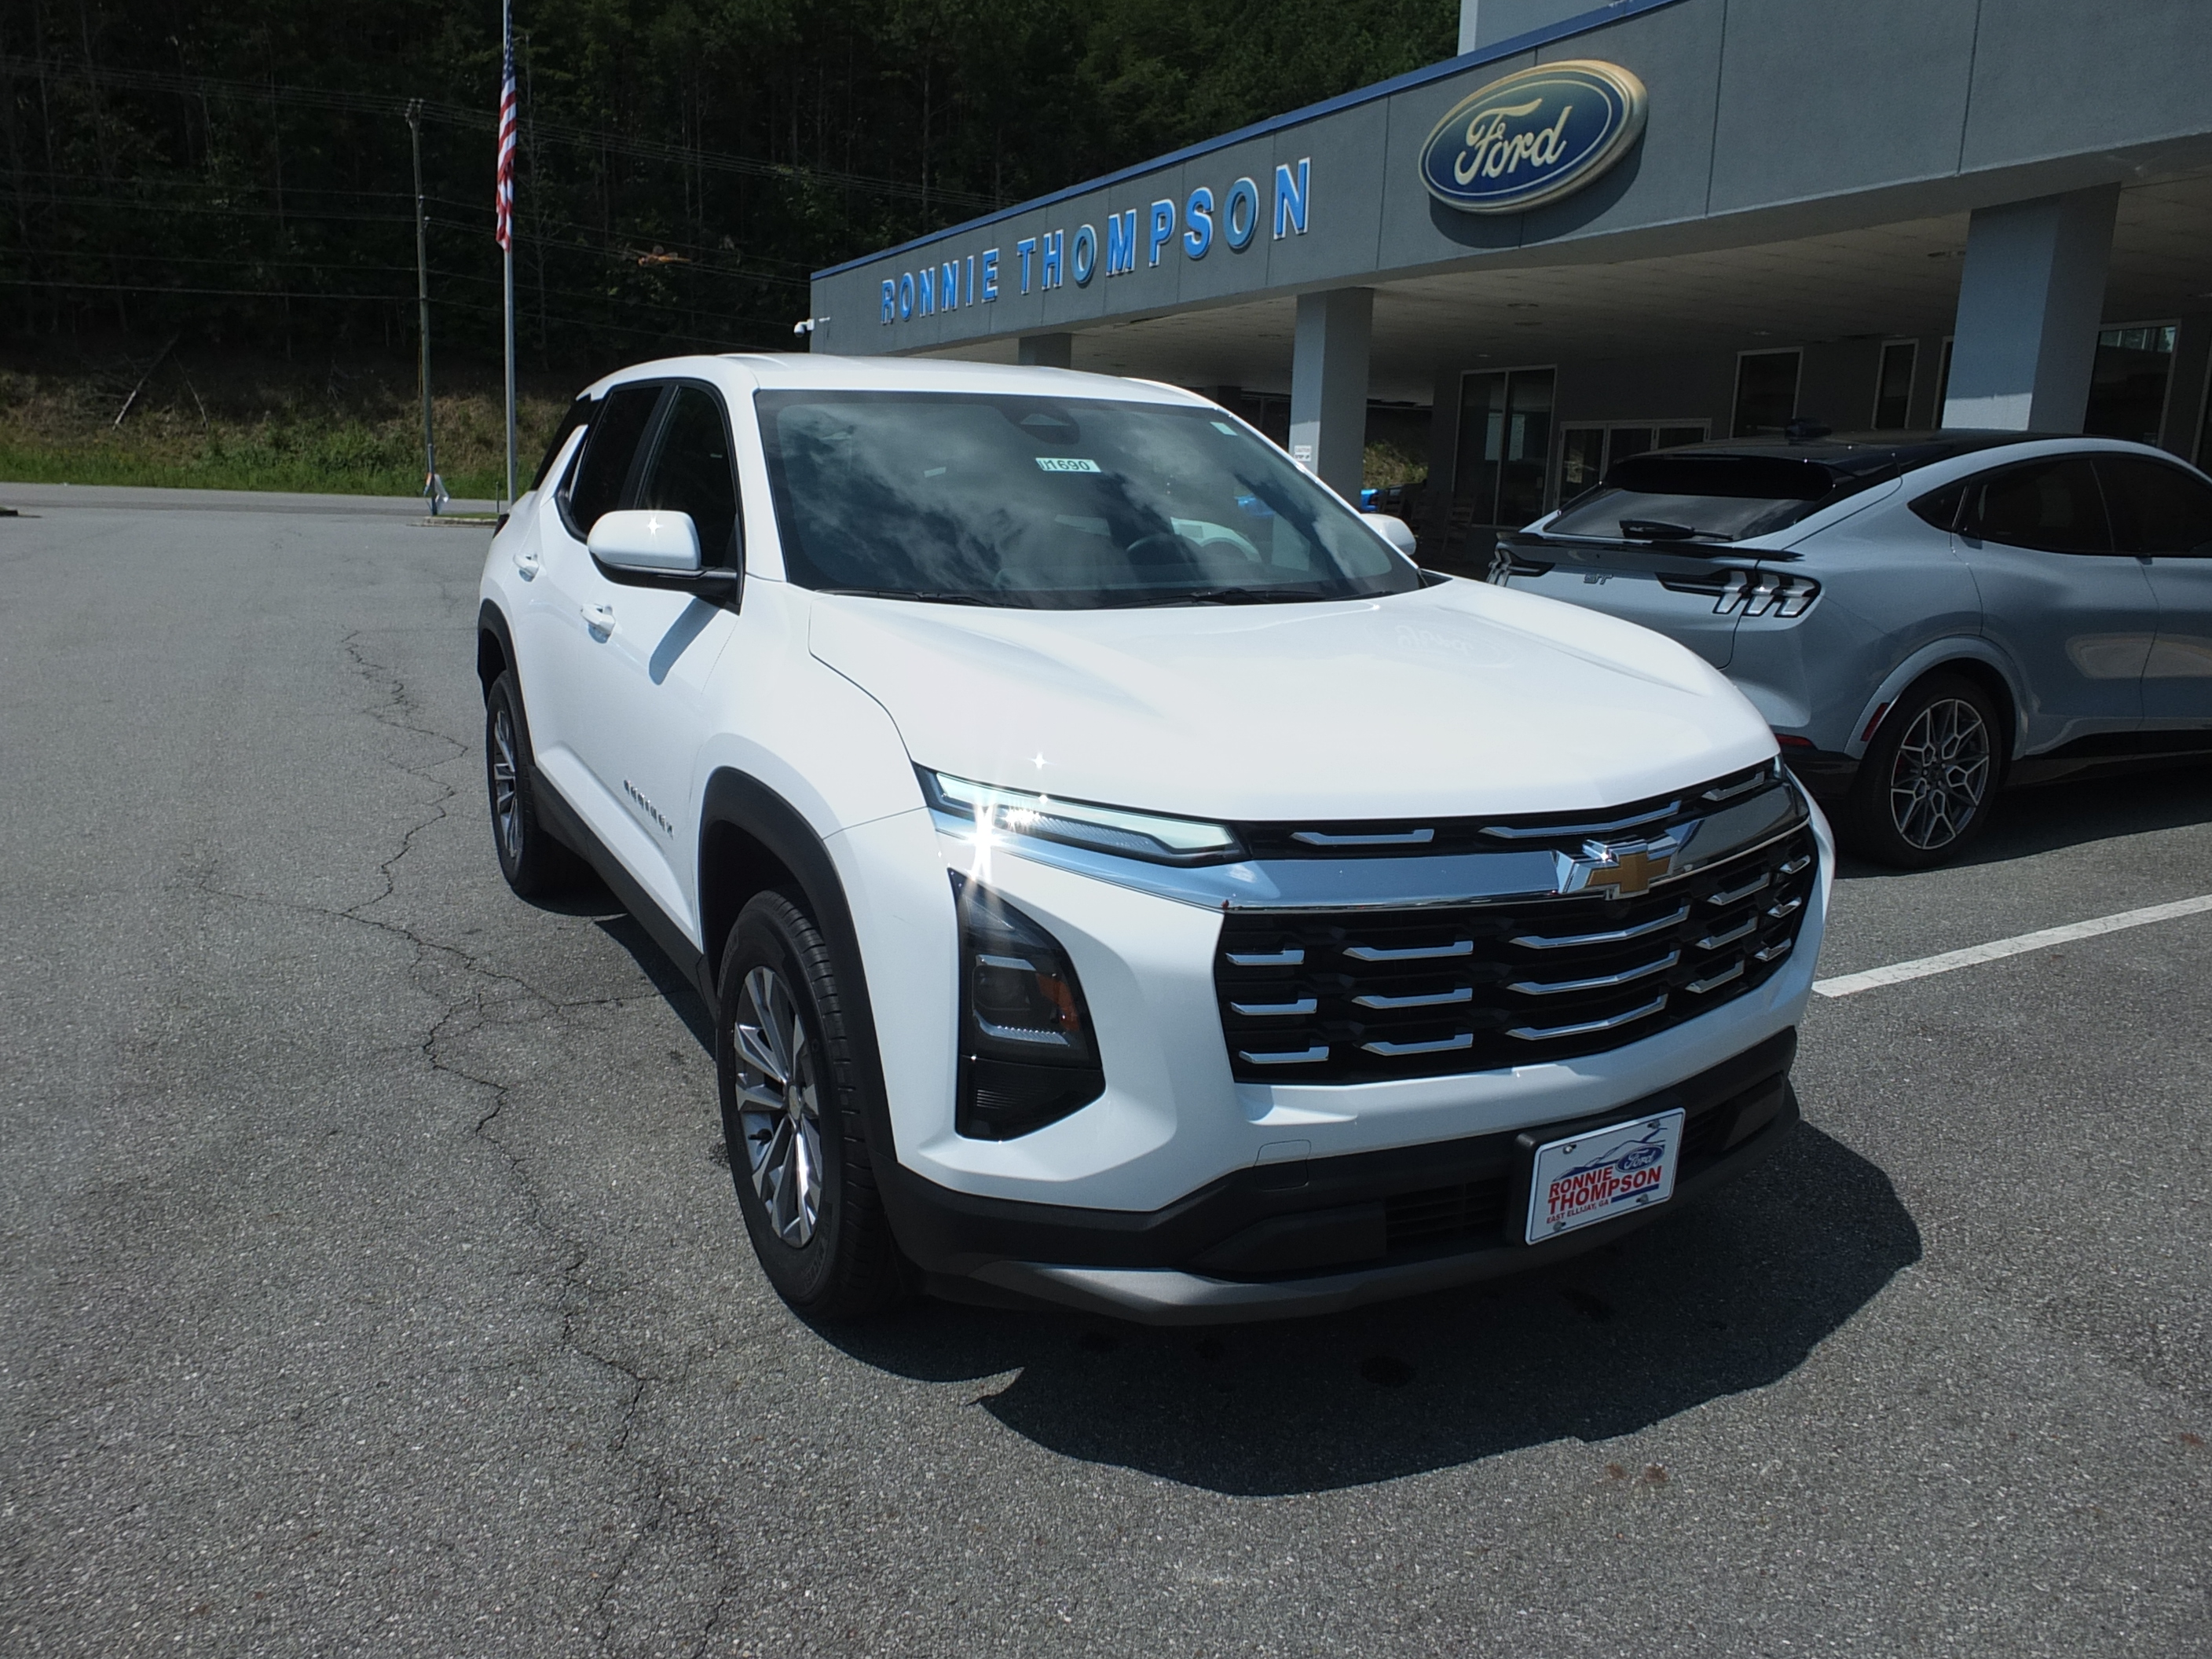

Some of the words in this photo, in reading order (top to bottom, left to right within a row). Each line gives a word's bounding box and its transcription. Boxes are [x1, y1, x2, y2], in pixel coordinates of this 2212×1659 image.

[1454, 97, 1573, 185] Ford
[880, 247, 1000, 325] RONNIE
[1016, 156, 1312, 295] THOMPSON
[1624, 1148, 1656, 1170] Ford
[1547, 1166, 1662, 1215] THOMPSON
[1549, 1166, 1614, 1198] RONNIE
[1546, 1212, 1566, 1225] EAST
[1599, 1199, 1610, 1207] GA
